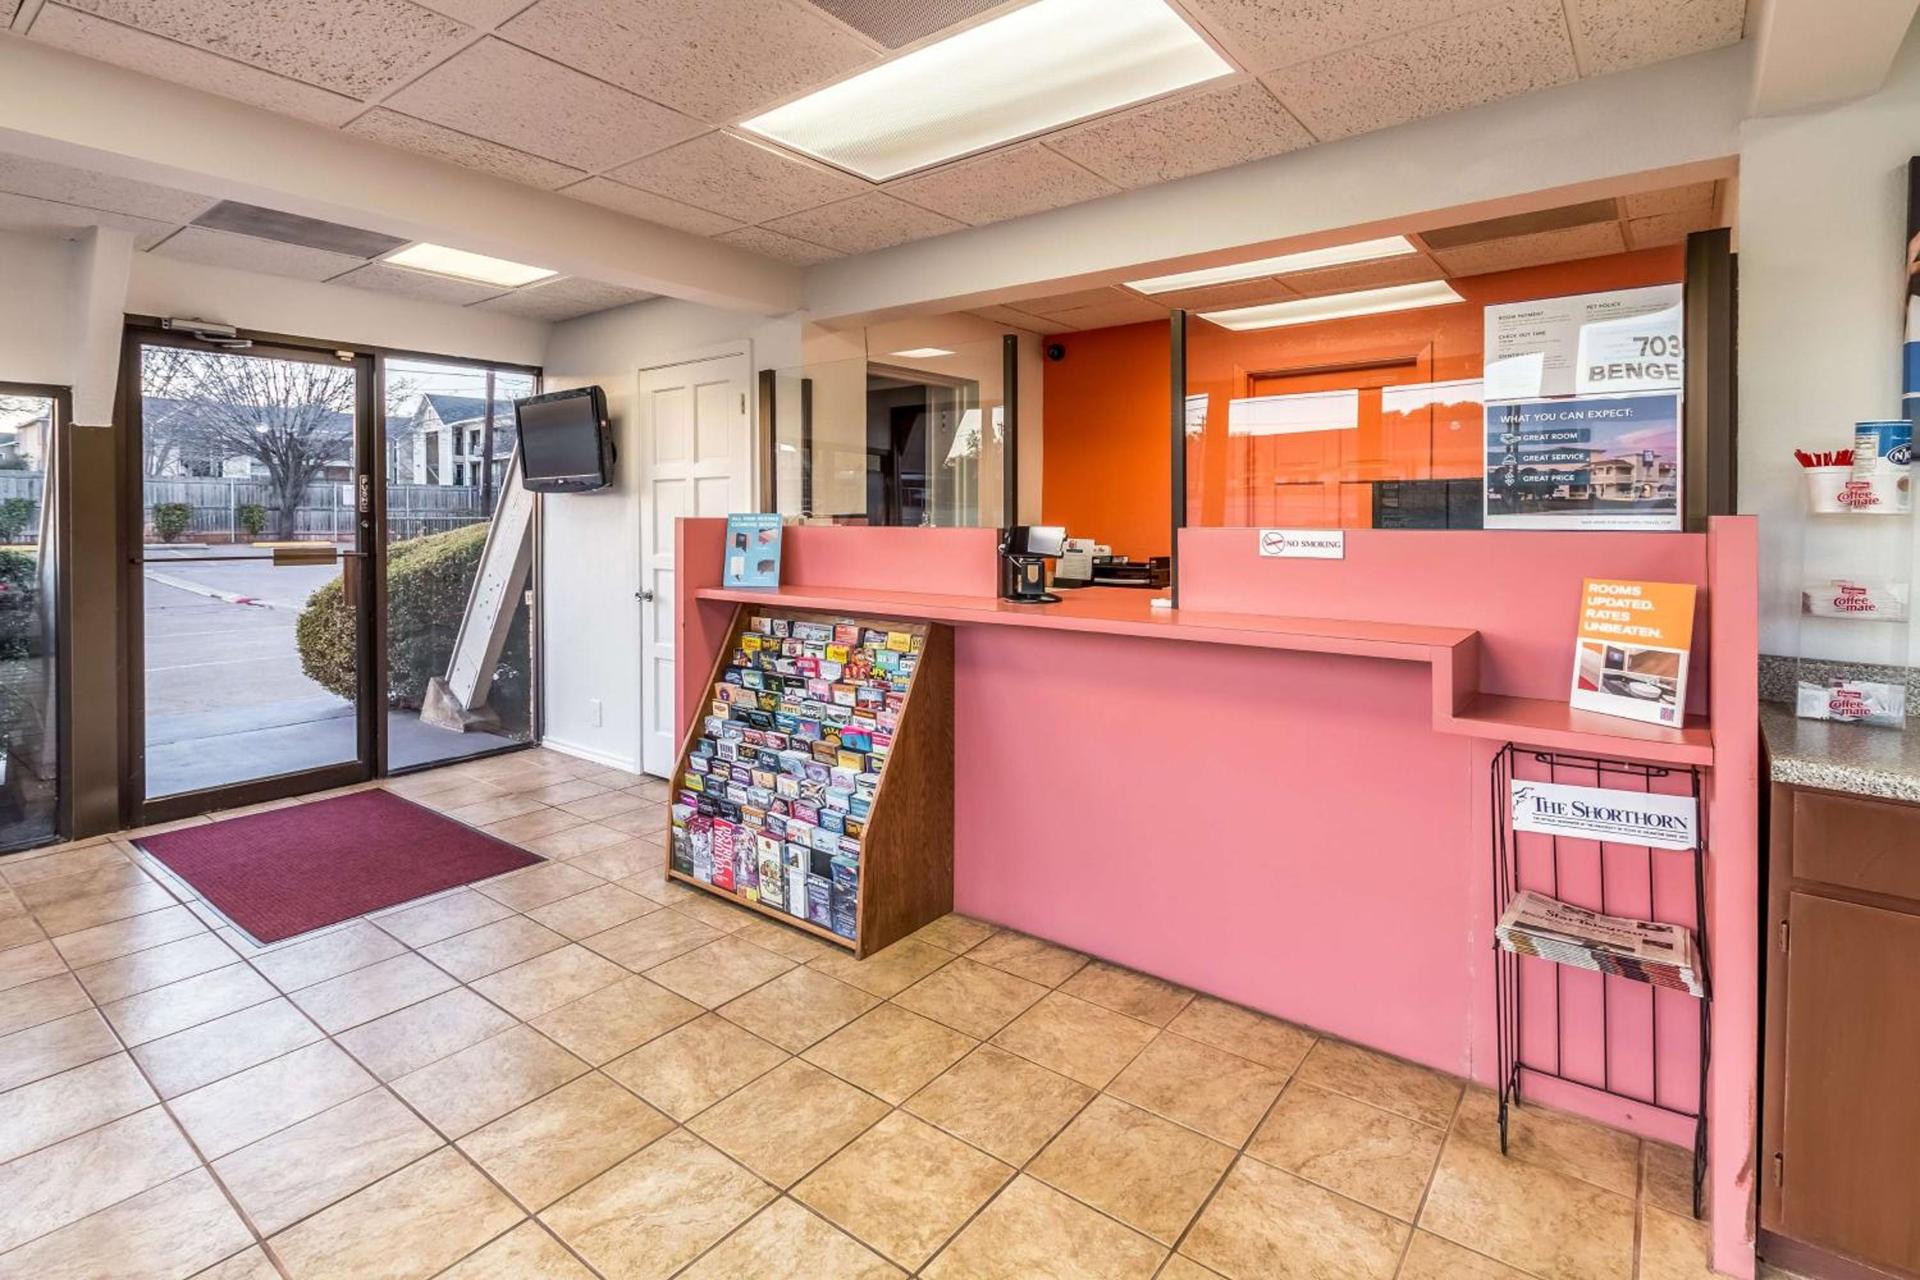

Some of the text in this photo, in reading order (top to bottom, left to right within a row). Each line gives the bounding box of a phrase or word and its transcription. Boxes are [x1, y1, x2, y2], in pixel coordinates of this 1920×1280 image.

[1633, 334, 1680, 357] 703
[1588, 361, 1681, 382] BENGE
[1500, 408, 1633, 423] WHAT YOU CAN EXPECT:
[1551, 453, 1584, 461] SERVICE
[1837, 491, 1873, 504] Coffee
[1849, 497, 1880, 506] mate
[1286, 539, 1342, 549] NO SMOKING
[1588, 583, 1643, 596] ROOMS
[1586, 596, 1655, 611] UPDATED.
[1833, 597, 1868, 607] Coffee
[1846, 604, 1876, 612] mate
[1585, 608, 1631, 622] RATES
[1583, 621, 1664, 639] UNBEATEN.
[1828, 699, 1864, 710] Coffee
[1840, 706, 1872, 716] mate
[1531, 795, 1568, 816] THE
